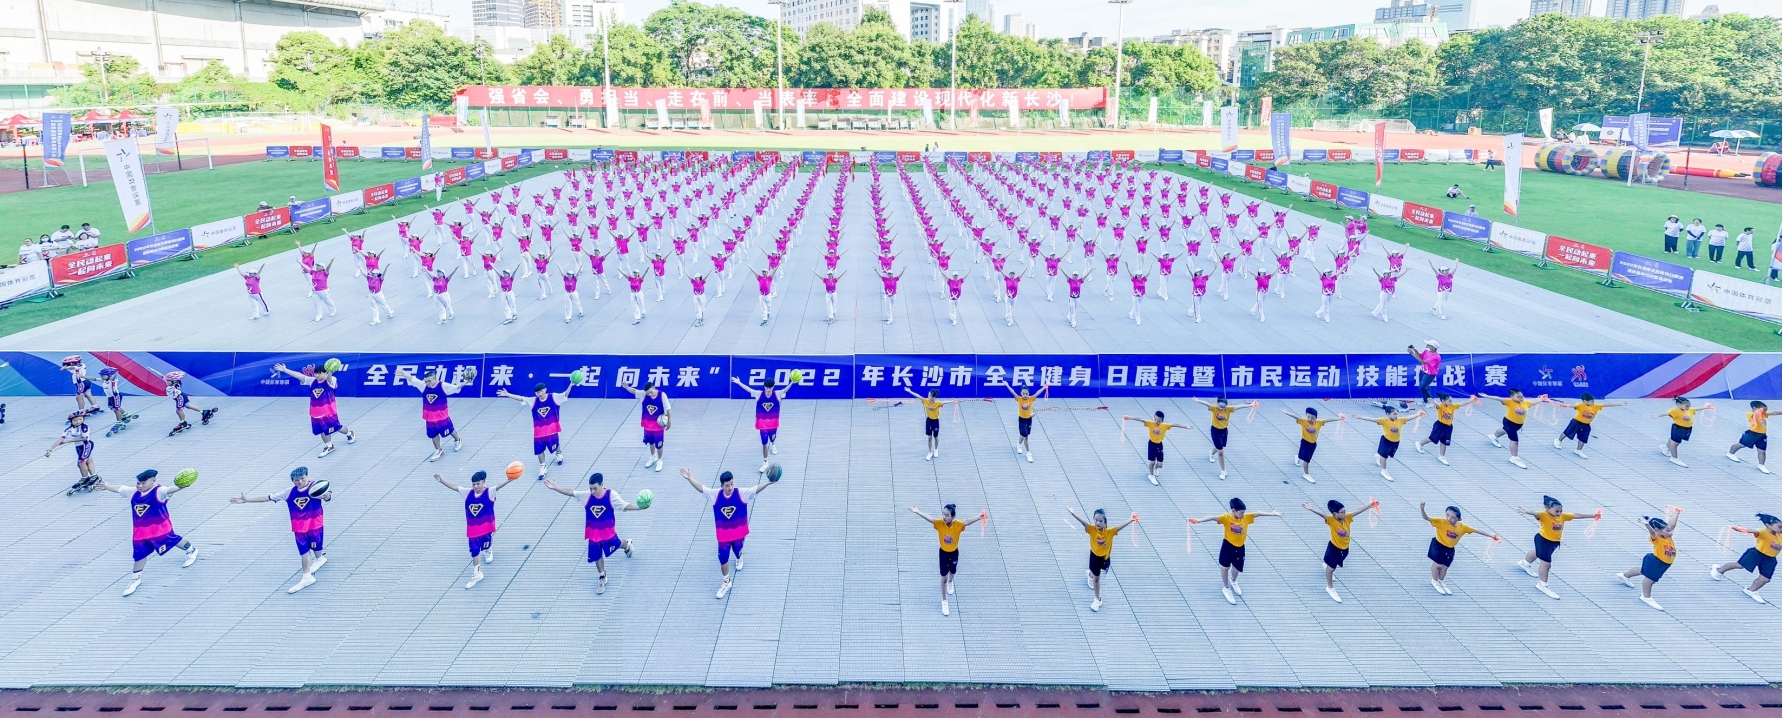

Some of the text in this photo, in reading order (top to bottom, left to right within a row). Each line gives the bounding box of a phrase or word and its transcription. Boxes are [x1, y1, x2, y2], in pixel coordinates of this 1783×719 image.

[67, 253, 112, 270] 全民动起来
